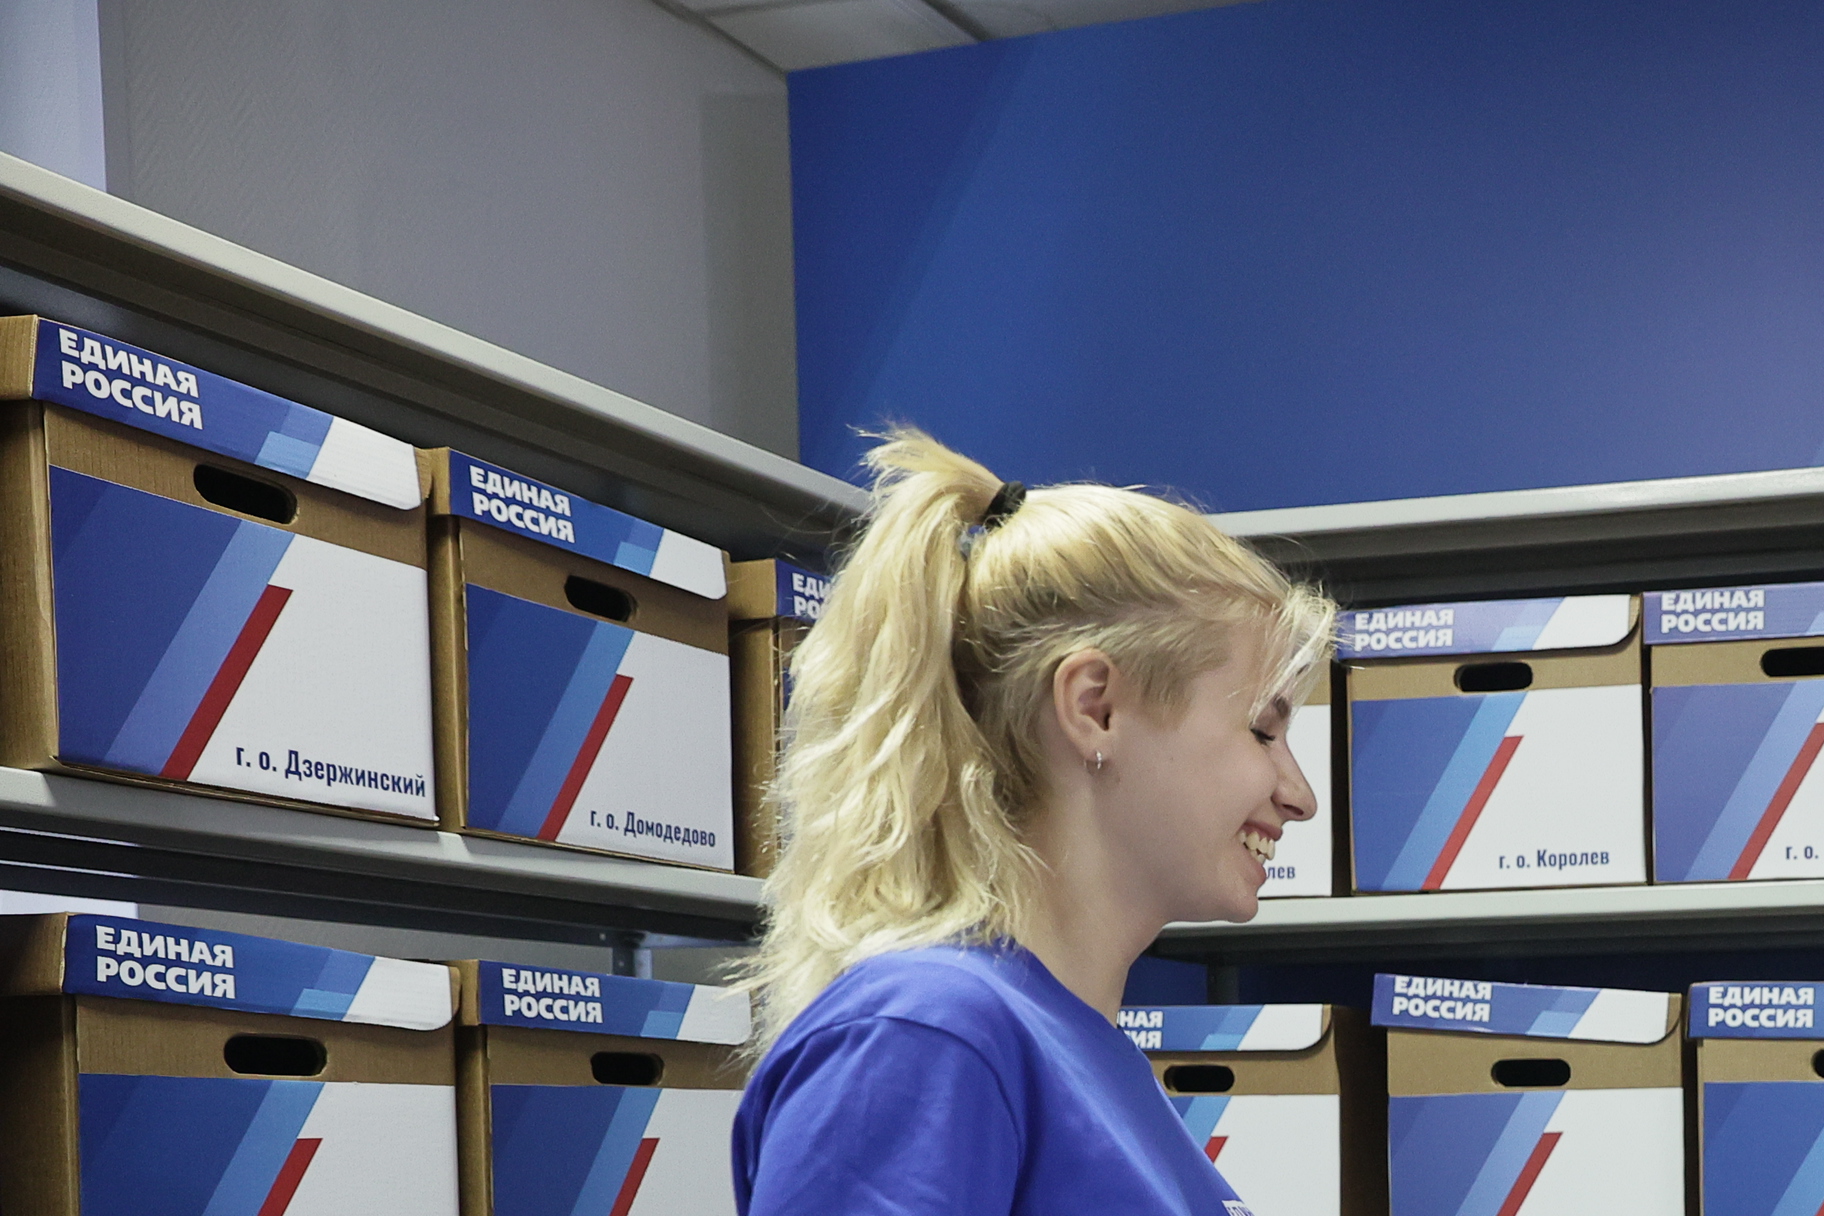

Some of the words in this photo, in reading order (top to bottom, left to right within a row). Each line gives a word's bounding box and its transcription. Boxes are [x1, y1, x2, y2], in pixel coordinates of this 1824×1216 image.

[58, 327, 199, 399] ЕДИНАЯ
[61, 360, 203, 430] РОССИЯ
[469, 465, 572, 517] ЕДИНАЯ
[472, 491, 575, 544] РОССИЯ
[1661, 586, 1765, 613] ЕДИНАЯ
[1354, 606, 1457, 631] ЕДИНАЯ
[1661, 610, 1765, 634] РОССИЯ
[1353, 627, 1454, 652] РОССИЯ
[236, 746, 251, 768] г.
[258, 751, 277, 772] о.
[284, 749, 426, 798] Дзержинский
[590, 810, 601, 828] г.
[606, 813, 619, 831] о.
[623, 811, 716, 848] Домодедово
[1499, 855, 1510, 869] г.
[1516, 855, 1530, 869] о.
[1536, 849, 1610, 871] Королев
[1785, 846, 1798, 860] г.
[1803, 845, 1819, 860] о.
[95, 925, 234, 969] ЕДИНАЯ
[96, 955, 236, 1000] РОССИЯ
[501, 967, 601, 998] ЕДИНАЯ
[1394, 975, 1494, 1001] ЕДИНАЯ
[503, 993, 603, 1024] РОССИЯ
[1392, 996, 1491, 1023] РОССИЯ
[1708, 986, 1815, 1007] ЕДИНАЯ
[1117, 1010, 1163, 1027] НАЯ
[1708, 1007, 1814, 1028] РОССИЯ
